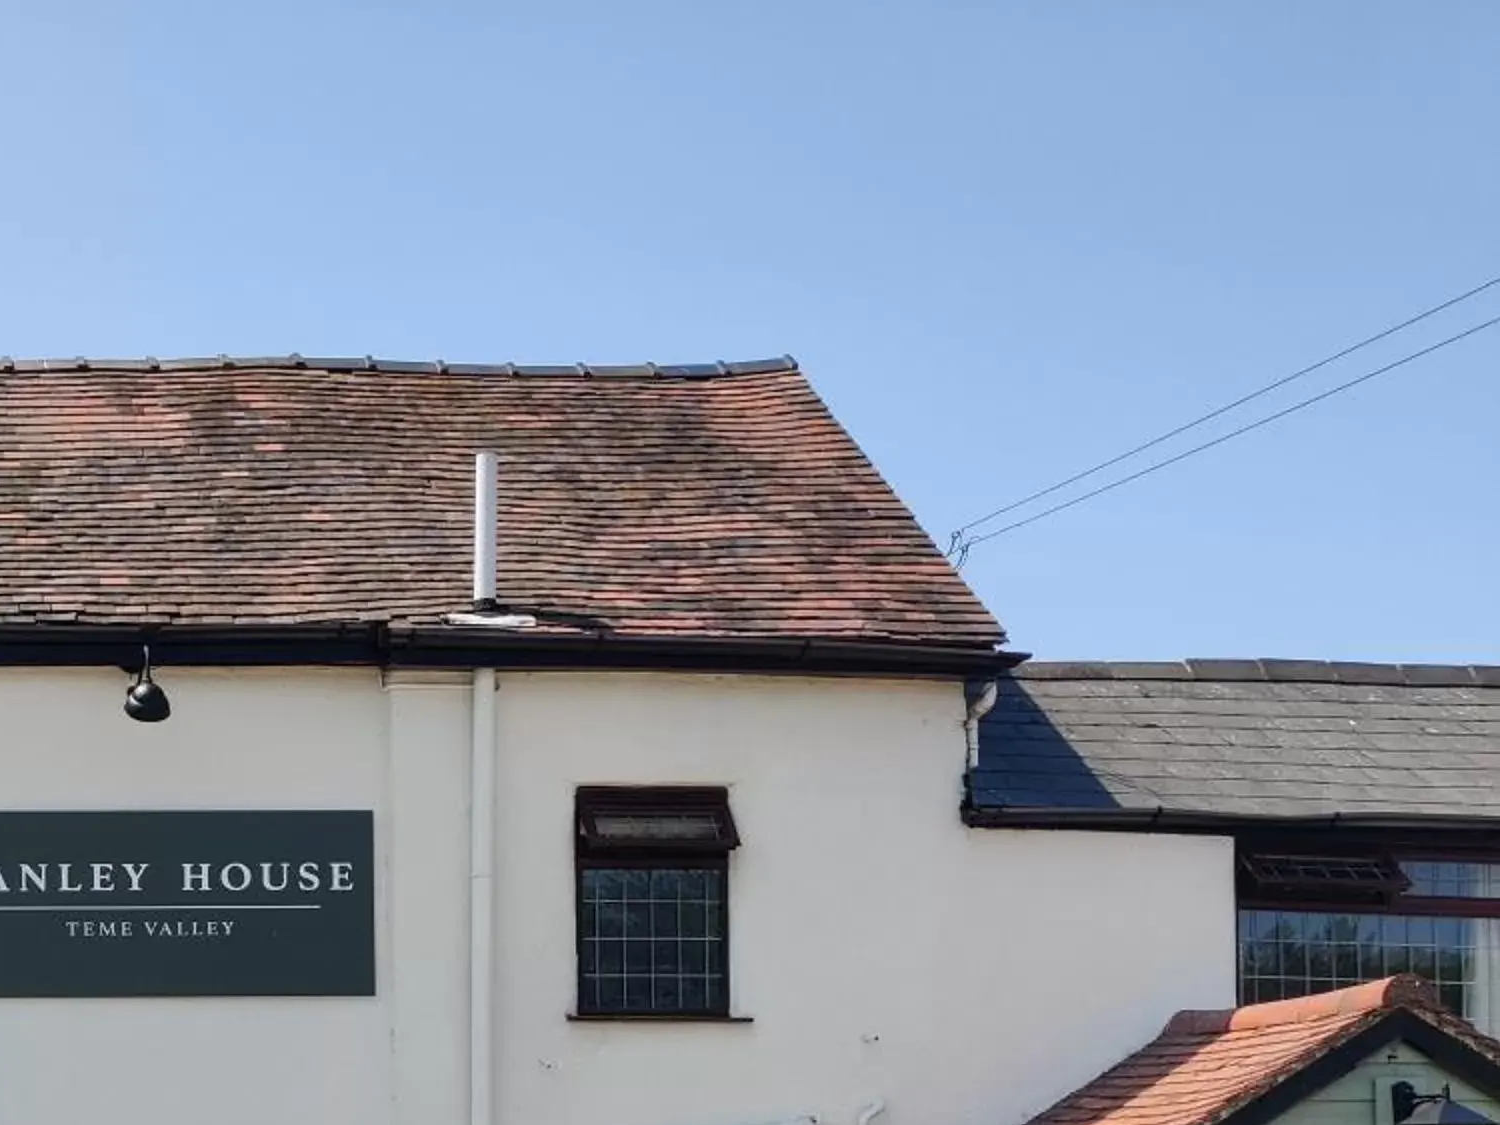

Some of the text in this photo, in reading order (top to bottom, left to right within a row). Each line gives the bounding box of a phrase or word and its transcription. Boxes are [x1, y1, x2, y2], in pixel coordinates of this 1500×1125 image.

[181, 862, 355, 892] HOUSE
[65, 920, 235, 938] TEME VALLEY
